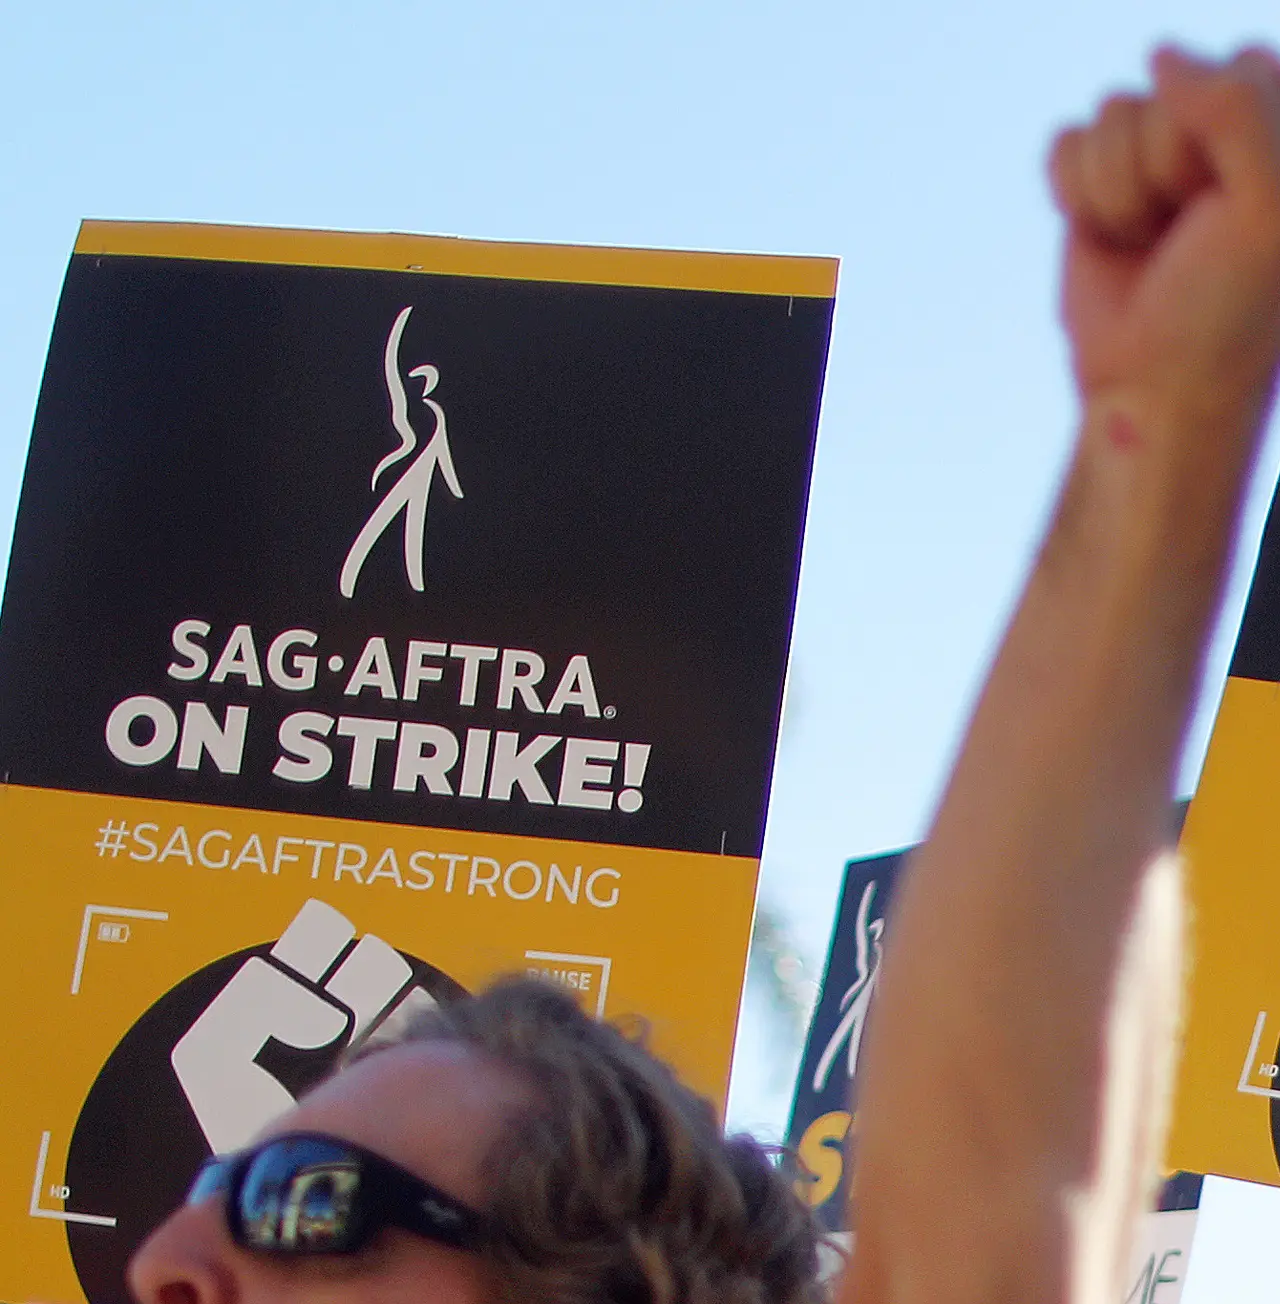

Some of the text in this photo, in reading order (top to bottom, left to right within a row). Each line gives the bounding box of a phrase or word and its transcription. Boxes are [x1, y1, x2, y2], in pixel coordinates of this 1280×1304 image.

[105, 695, 652, 813] ON STRIKE!
[94, 819, 622, 909] #SAGAFTRASTRONG
[1259, 1063, 1279, 1077] HD
[50, 1184, 71, 1200] HD
